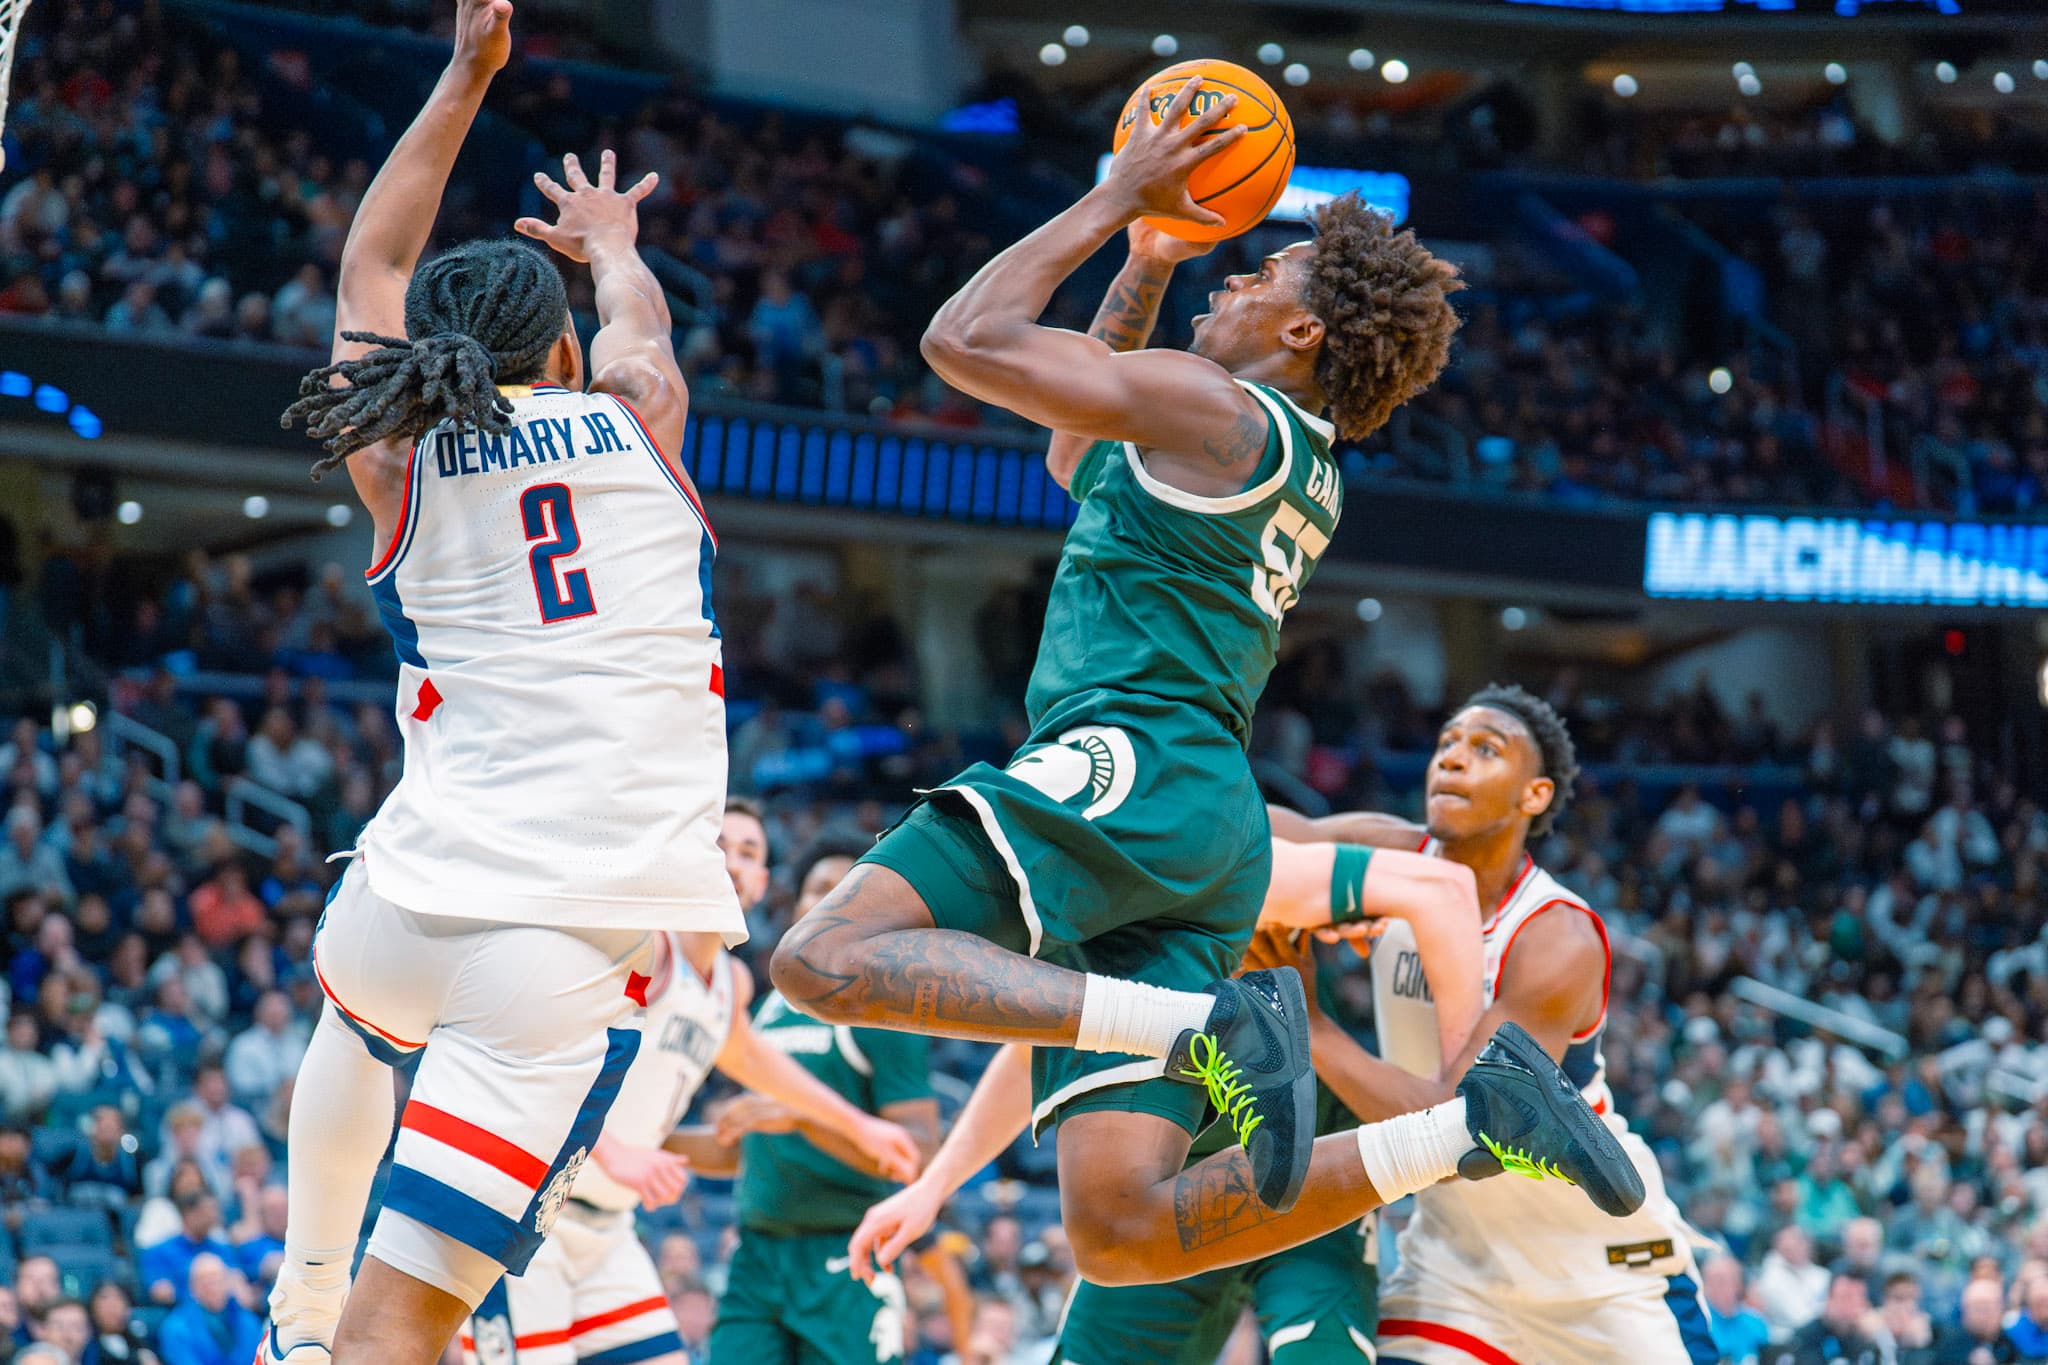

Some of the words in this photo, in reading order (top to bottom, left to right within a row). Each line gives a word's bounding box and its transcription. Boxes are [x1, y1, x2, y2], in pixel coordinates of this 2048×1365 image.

[436, 418, 577, 478] DEMARY
[582, 412, 632, 455] JR.
[520, 482, 597, 624] 2
